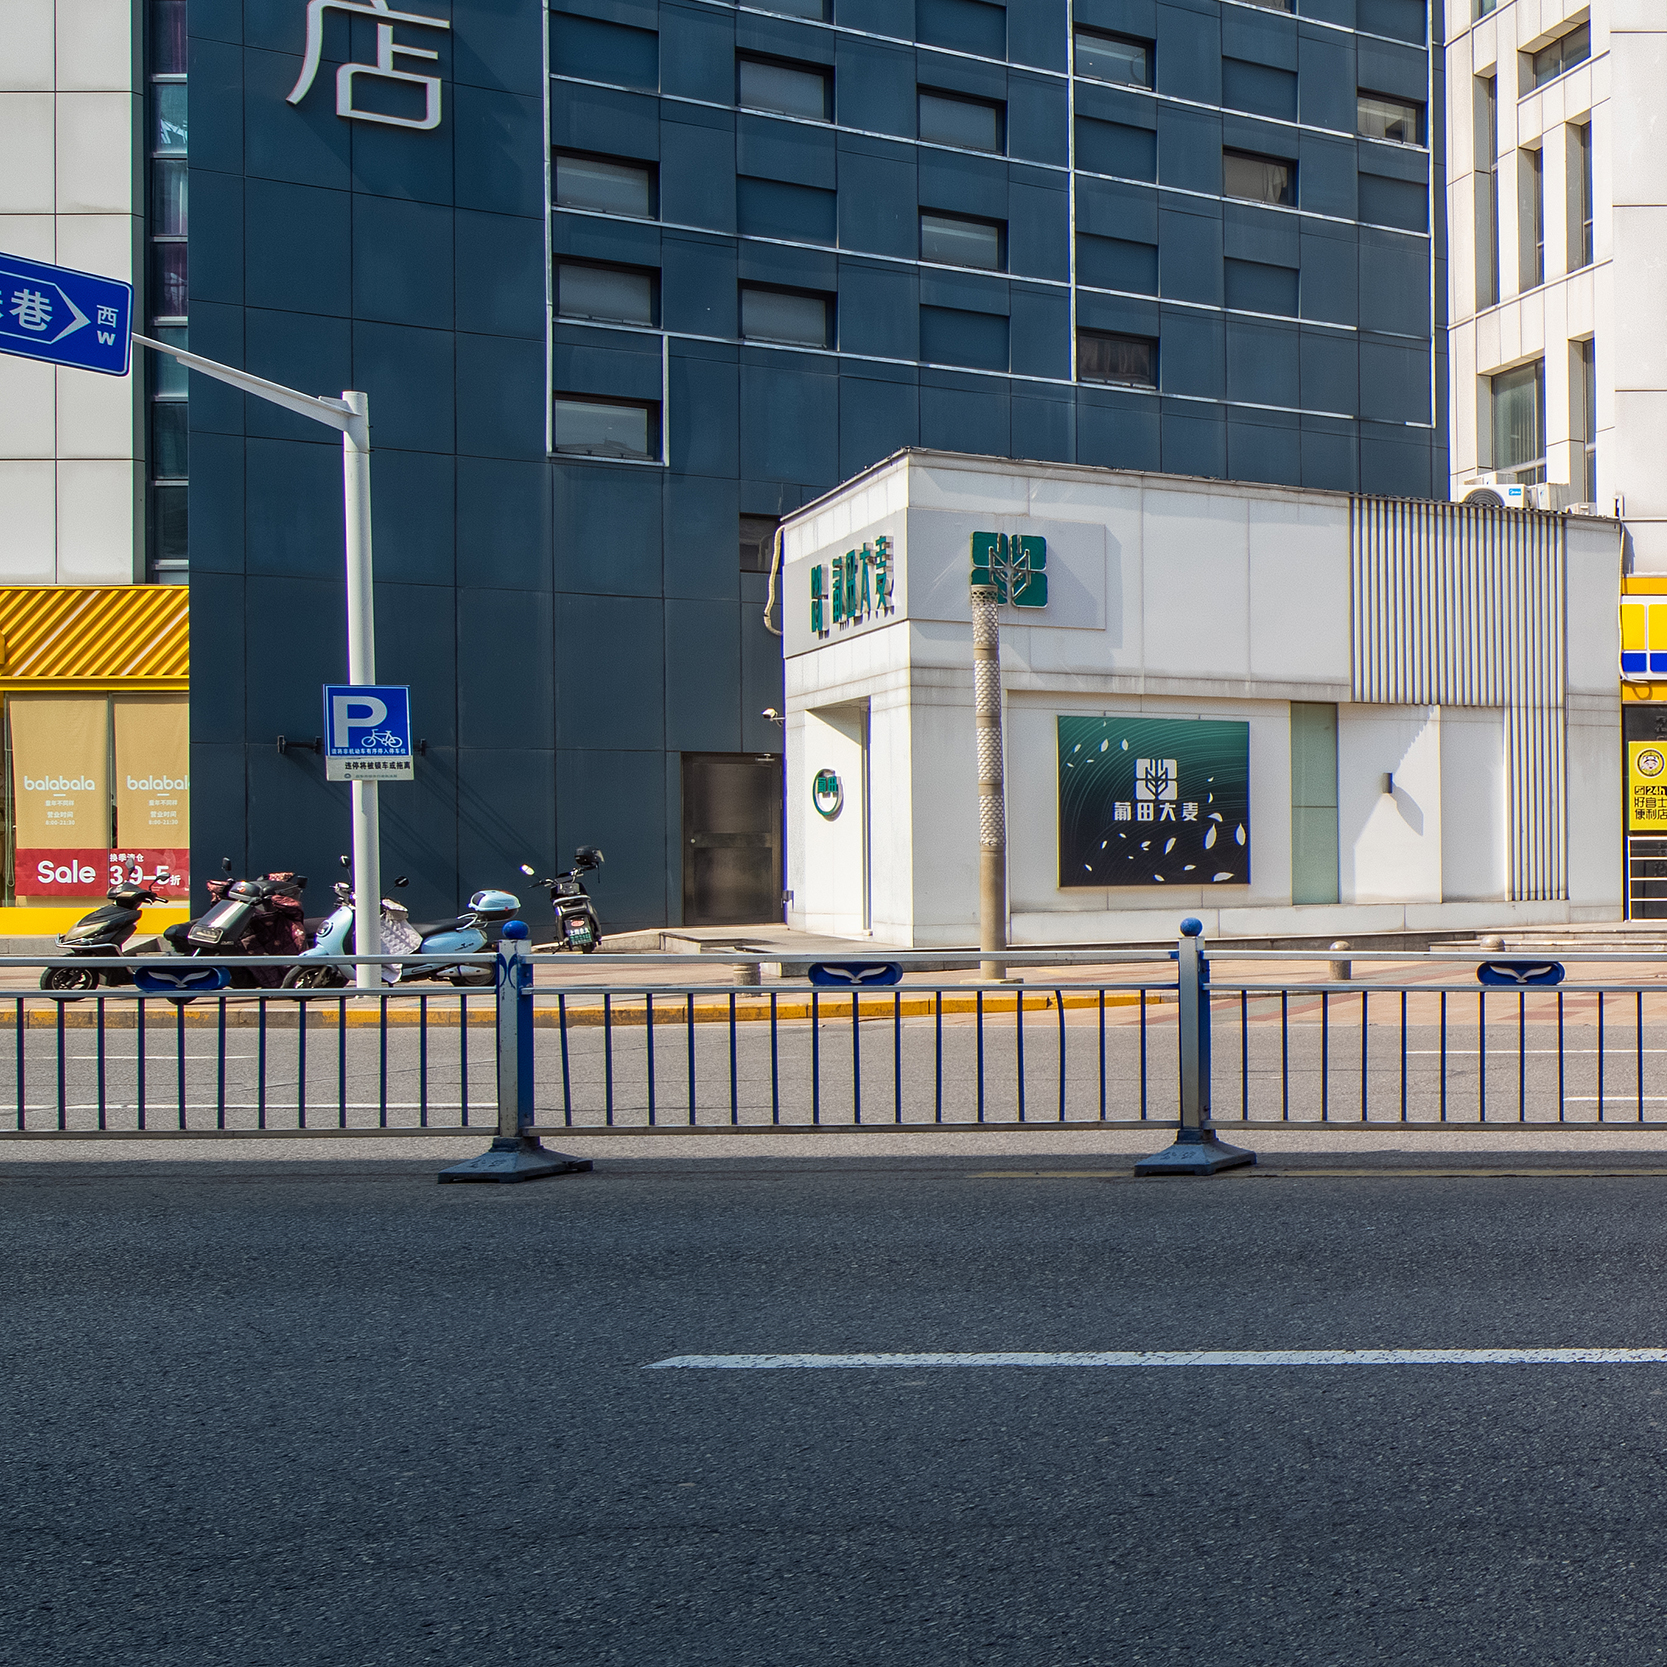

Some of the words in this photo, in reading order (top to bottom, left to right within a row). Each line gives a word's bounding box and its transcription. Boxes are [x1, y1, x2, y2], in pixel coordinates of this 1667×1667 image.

[0, 287, 53, 331] 巷
[97, 305, 119, 328] 西
[97, 330, 116, 346] W
[333, 696, 387, 747] P
[24, 776, 95, 791] balabala
[127, 775, 189, 791] balabal
[1634, 808, 1667, 820] 便利店
[37, 860, 96, 884] Sale
